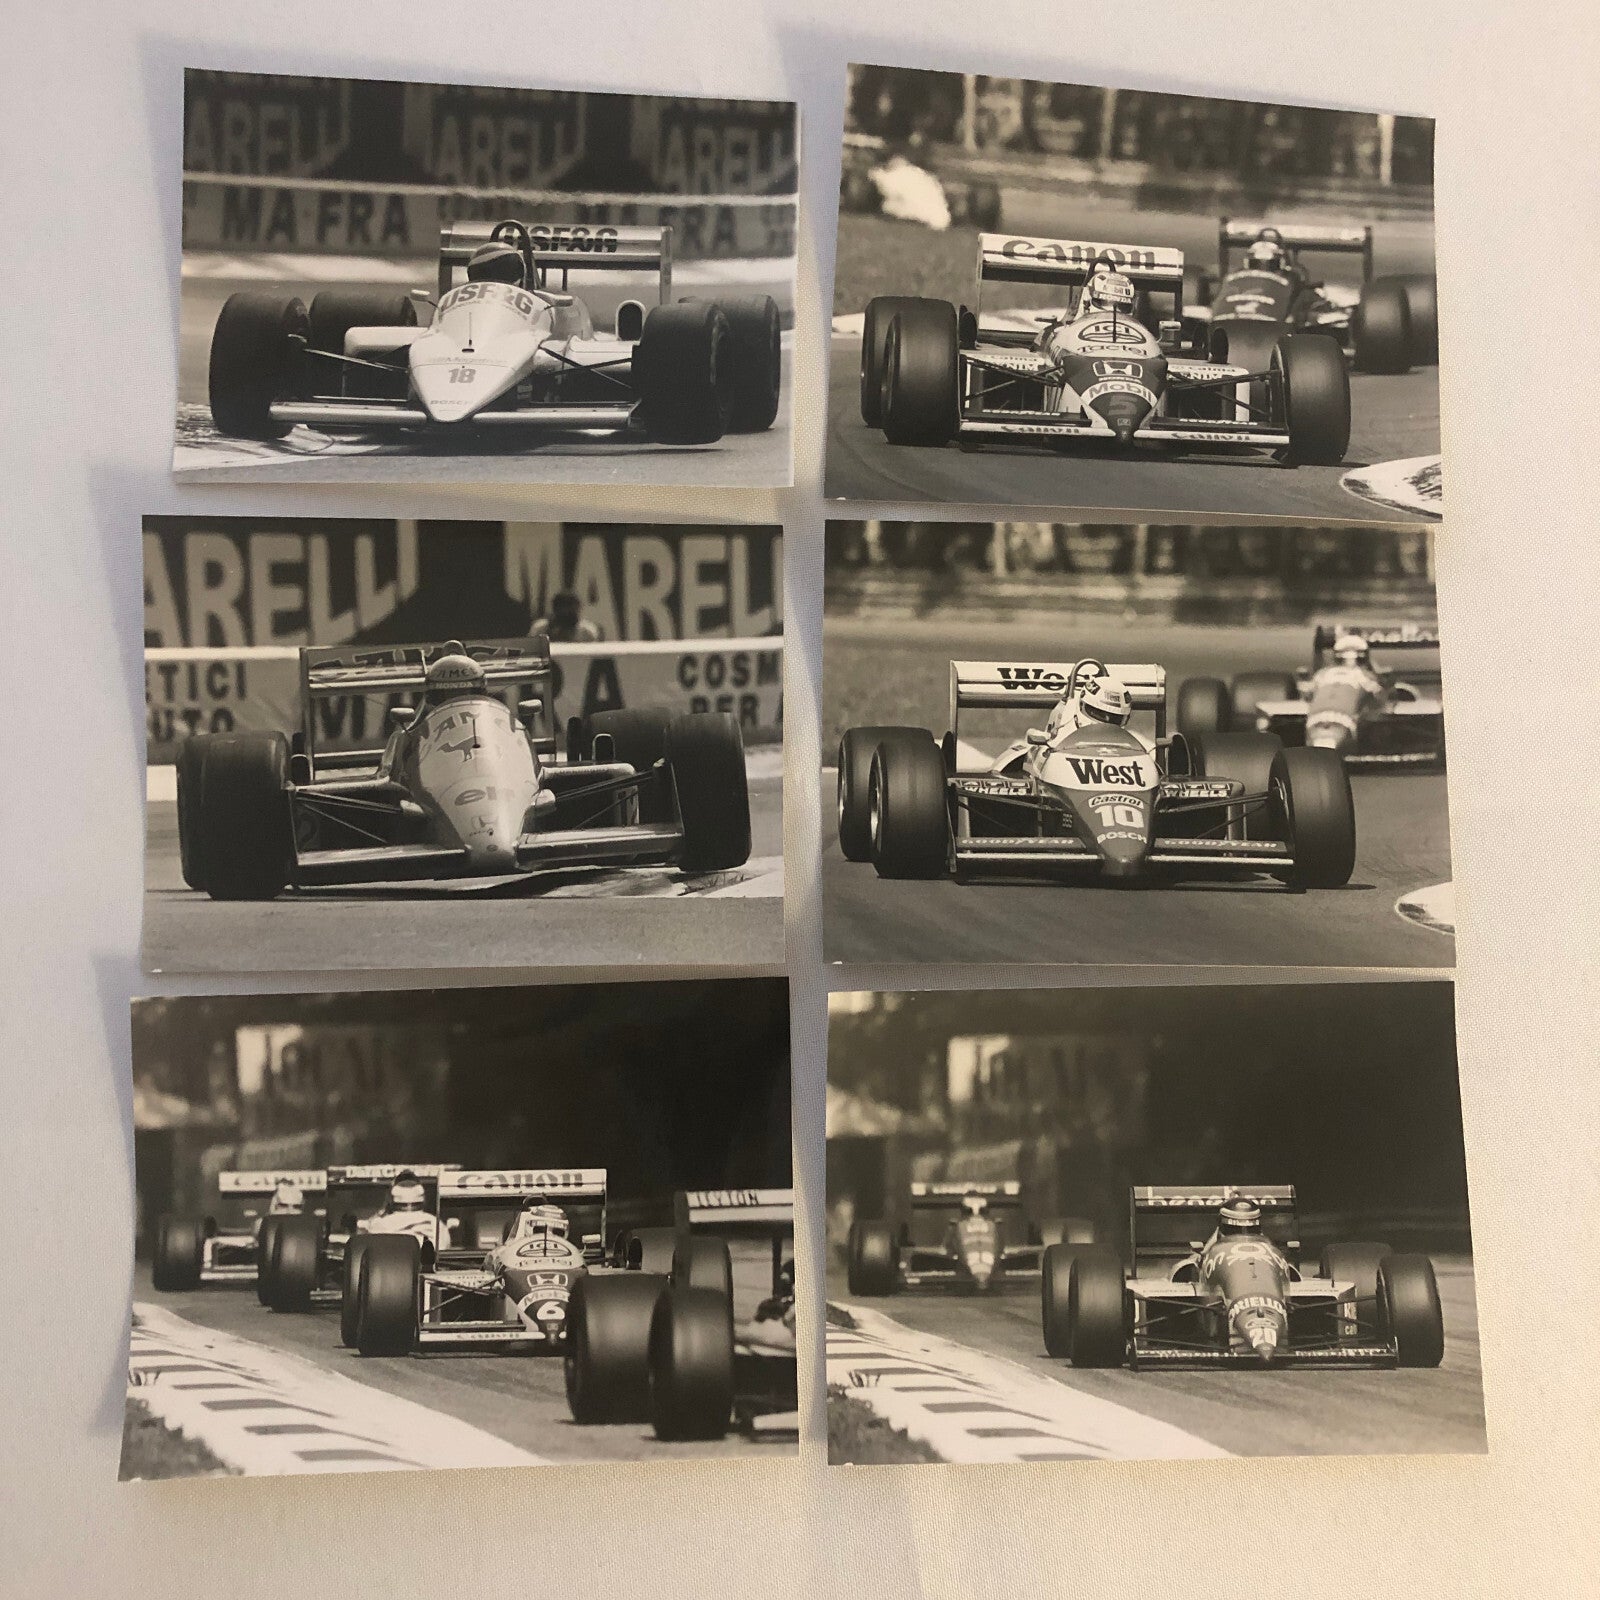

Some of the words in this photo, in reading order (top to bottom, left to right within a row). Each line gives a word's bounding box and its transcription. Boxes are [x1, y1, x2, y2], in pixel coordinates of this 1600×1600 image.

[1003, 240, 1155, 270] Canon
[448, 368, 477, 384] 18
[1088, 383, 1153, 403] Mobil
[145, 660, 248, 704] TICI
[435, 682, 474, 690] HONDA
[997, 668, 1090, 691] We
[1065, 758, 1147, 788] West
[1091, 795, 1142, 807] Castrol
[1094, 805, 1145, 829] 10
[1097, 831, 1148, 844] BOSCH
[457, 1172, 583, 1189] Canon
[537, 1301, 565, 1320] 6
[1249, 1327, 1277, 1349] 20
